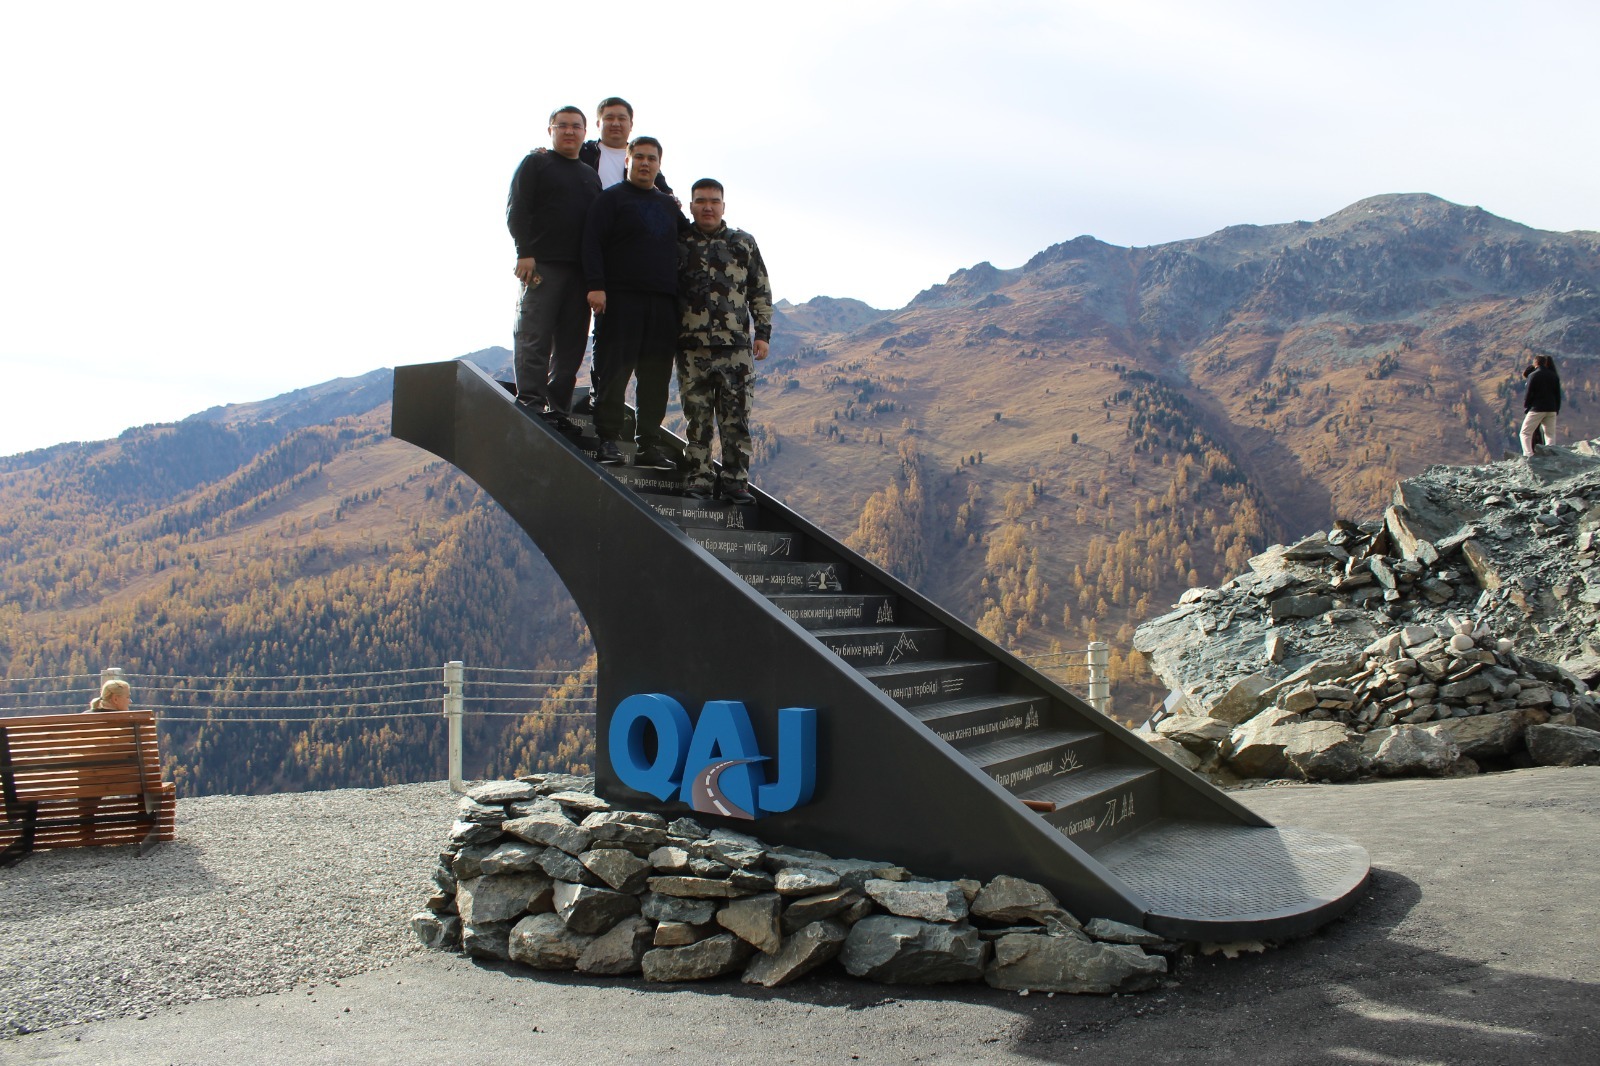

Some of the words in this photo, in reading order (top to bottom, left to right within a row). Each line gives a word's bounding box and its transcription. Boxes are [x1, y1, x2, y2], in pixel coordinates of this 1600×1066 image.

[682, 507, 708, 520] мәңгілік
[709, 510, 724, 522] мұра
[705, 538, 718, 552] бар
[718, 540, 738, 553] жерде
[757, 541, 768, 555] бар
[770, 574, 786, 586] жаңа
[608, 693, 817, 821] QAJ
